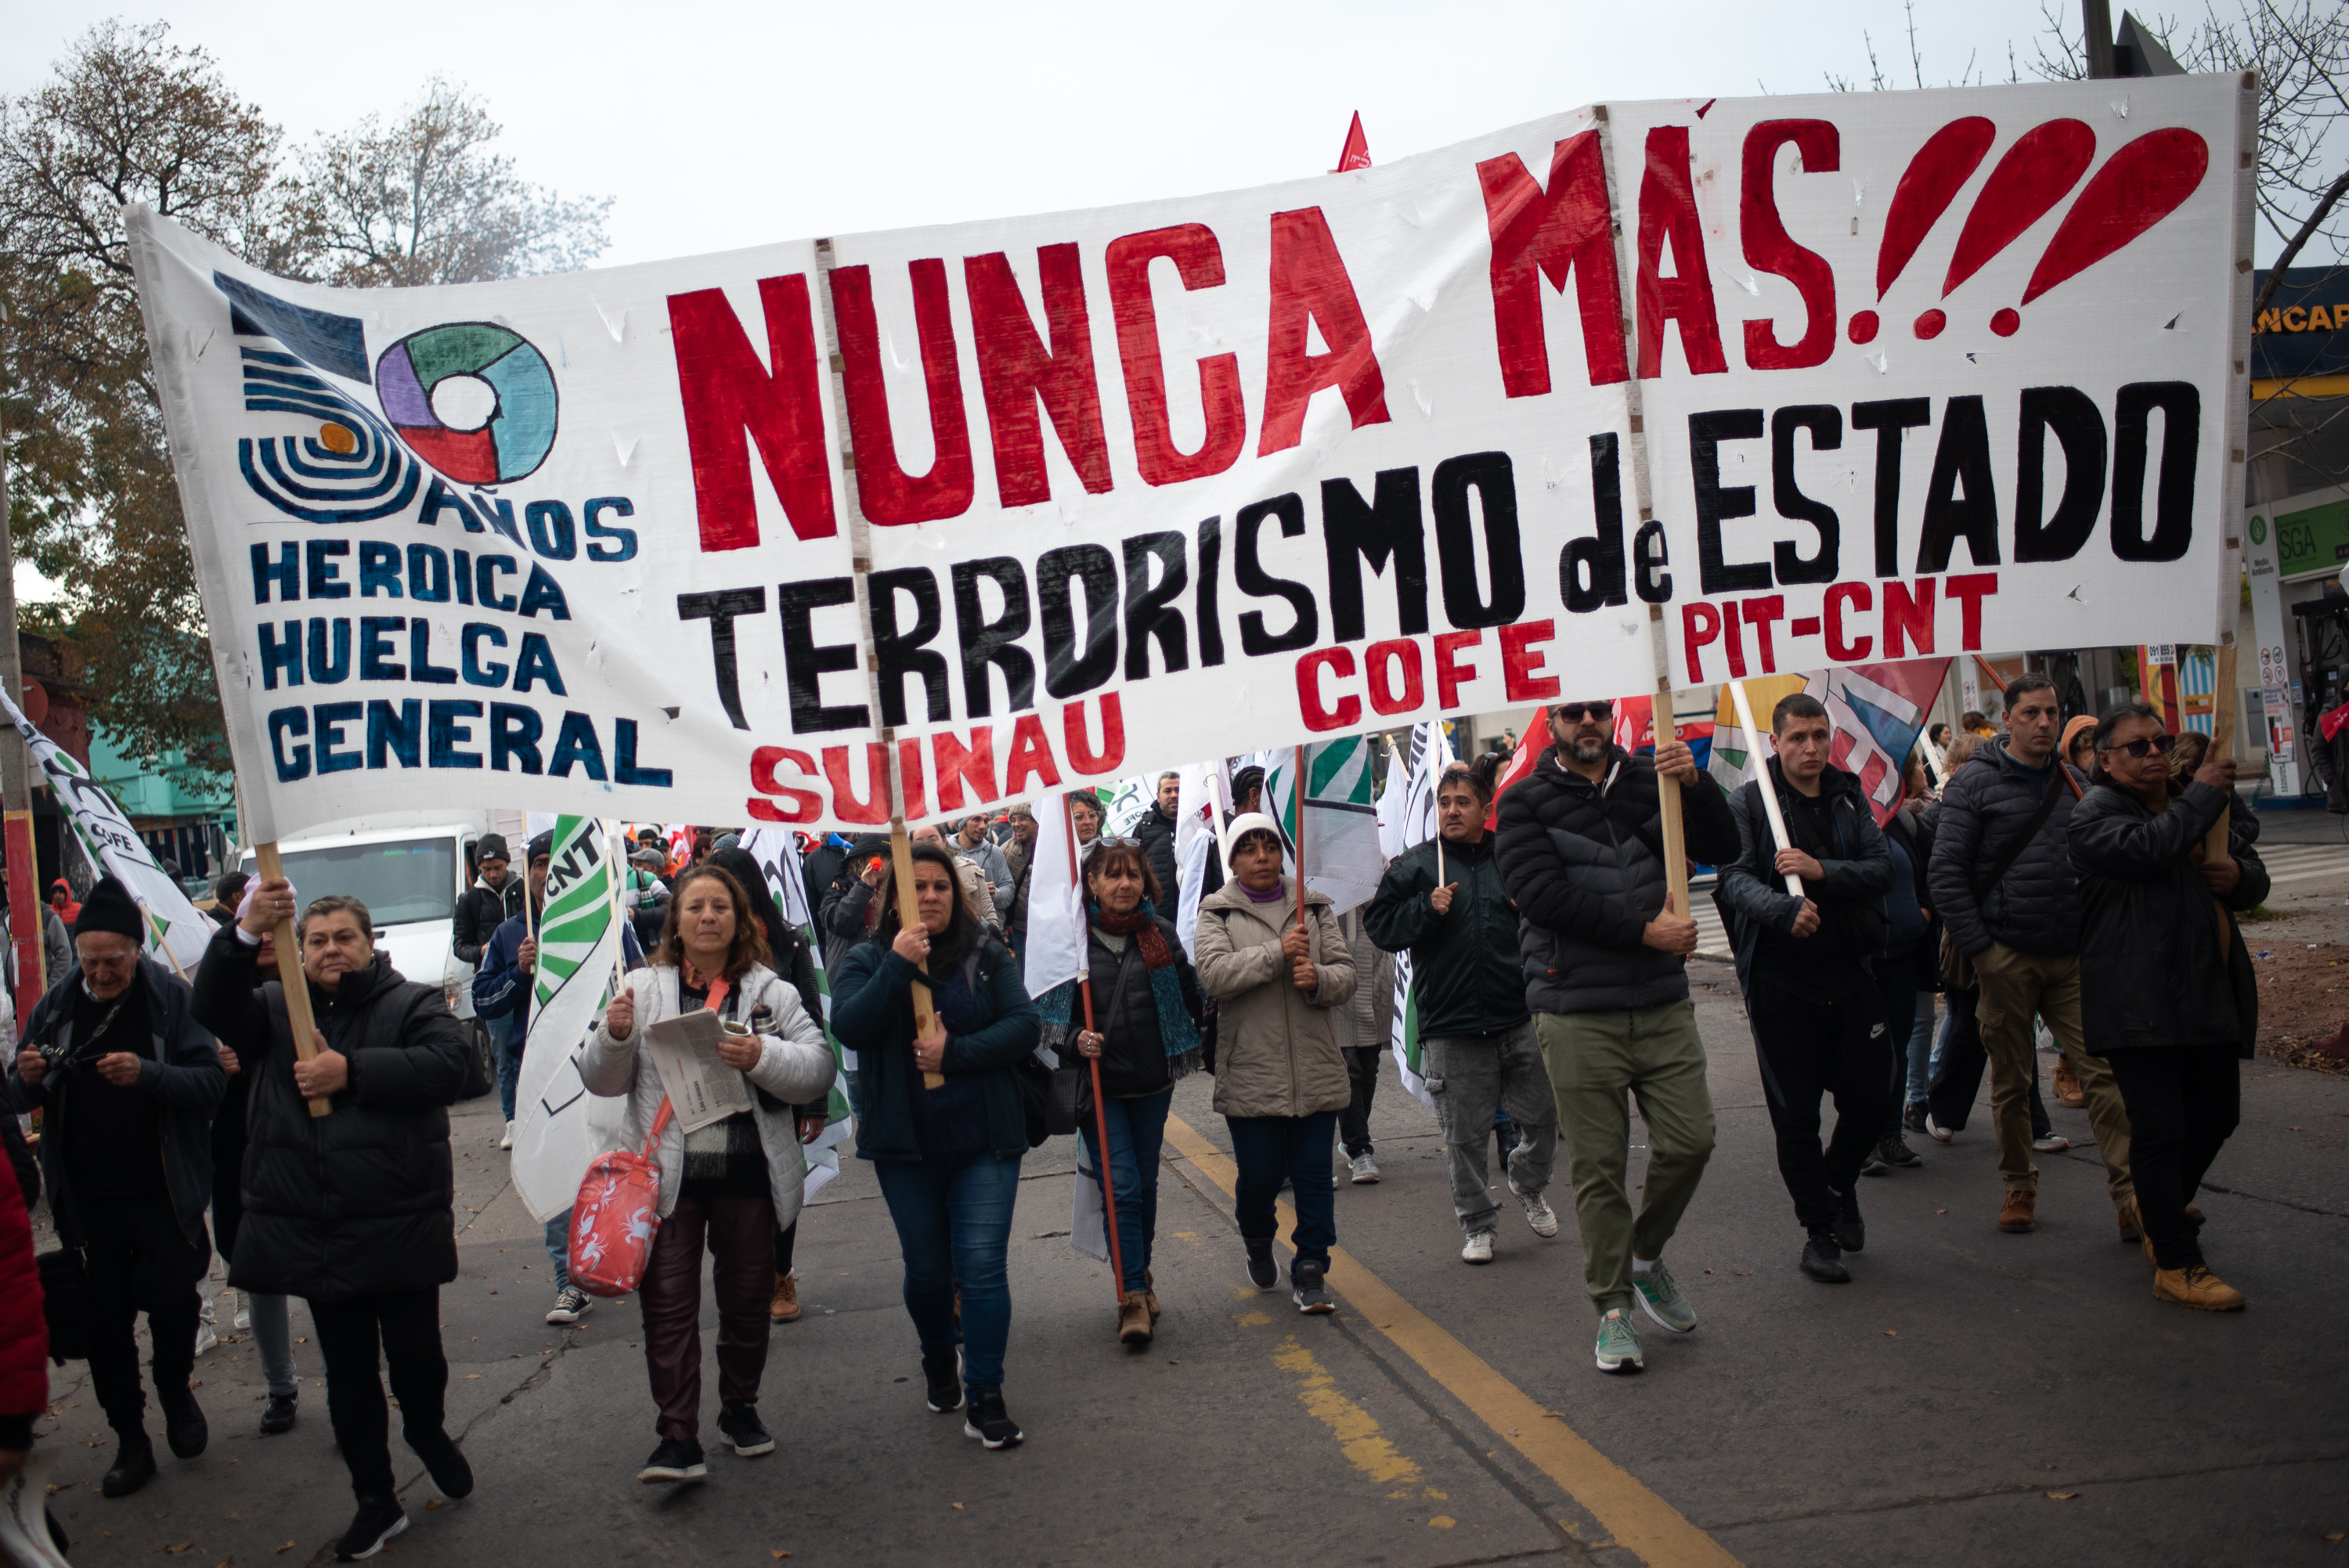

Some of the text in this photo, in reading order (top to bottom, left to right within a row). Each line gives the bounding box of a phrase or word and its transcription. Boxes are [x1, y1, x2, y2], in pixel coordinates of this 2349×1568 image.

[2252, 304, 2349, 334] NCAP
[666, 206, 1391, 552] NUNCA
[418, 473, 638, 563] AÑOS
[2279, 524, 2317, 561] SGA
[250, 539, 572, 621] HEROICA
[677, 381, 2201, 734] TERRORISMO de ESTADO
[2252, 566, 2275, 576] Ambiente
[2254, 557, 2269, 568] Medio
[258, 616, 568, 697] HUELGA
[2149, 646, 2160, 657] 091
[2160, 645, 2170, 656] 855
[746, 573, 1998, 826] SUINAU COFE PIT-CNT
[268, 698, 673, 788] GENERAL
[546, 821, 600, 898] CNT
[1872, 1022, 1884, 1033] NIKE
[694, 1080, 703, 1100] causas
